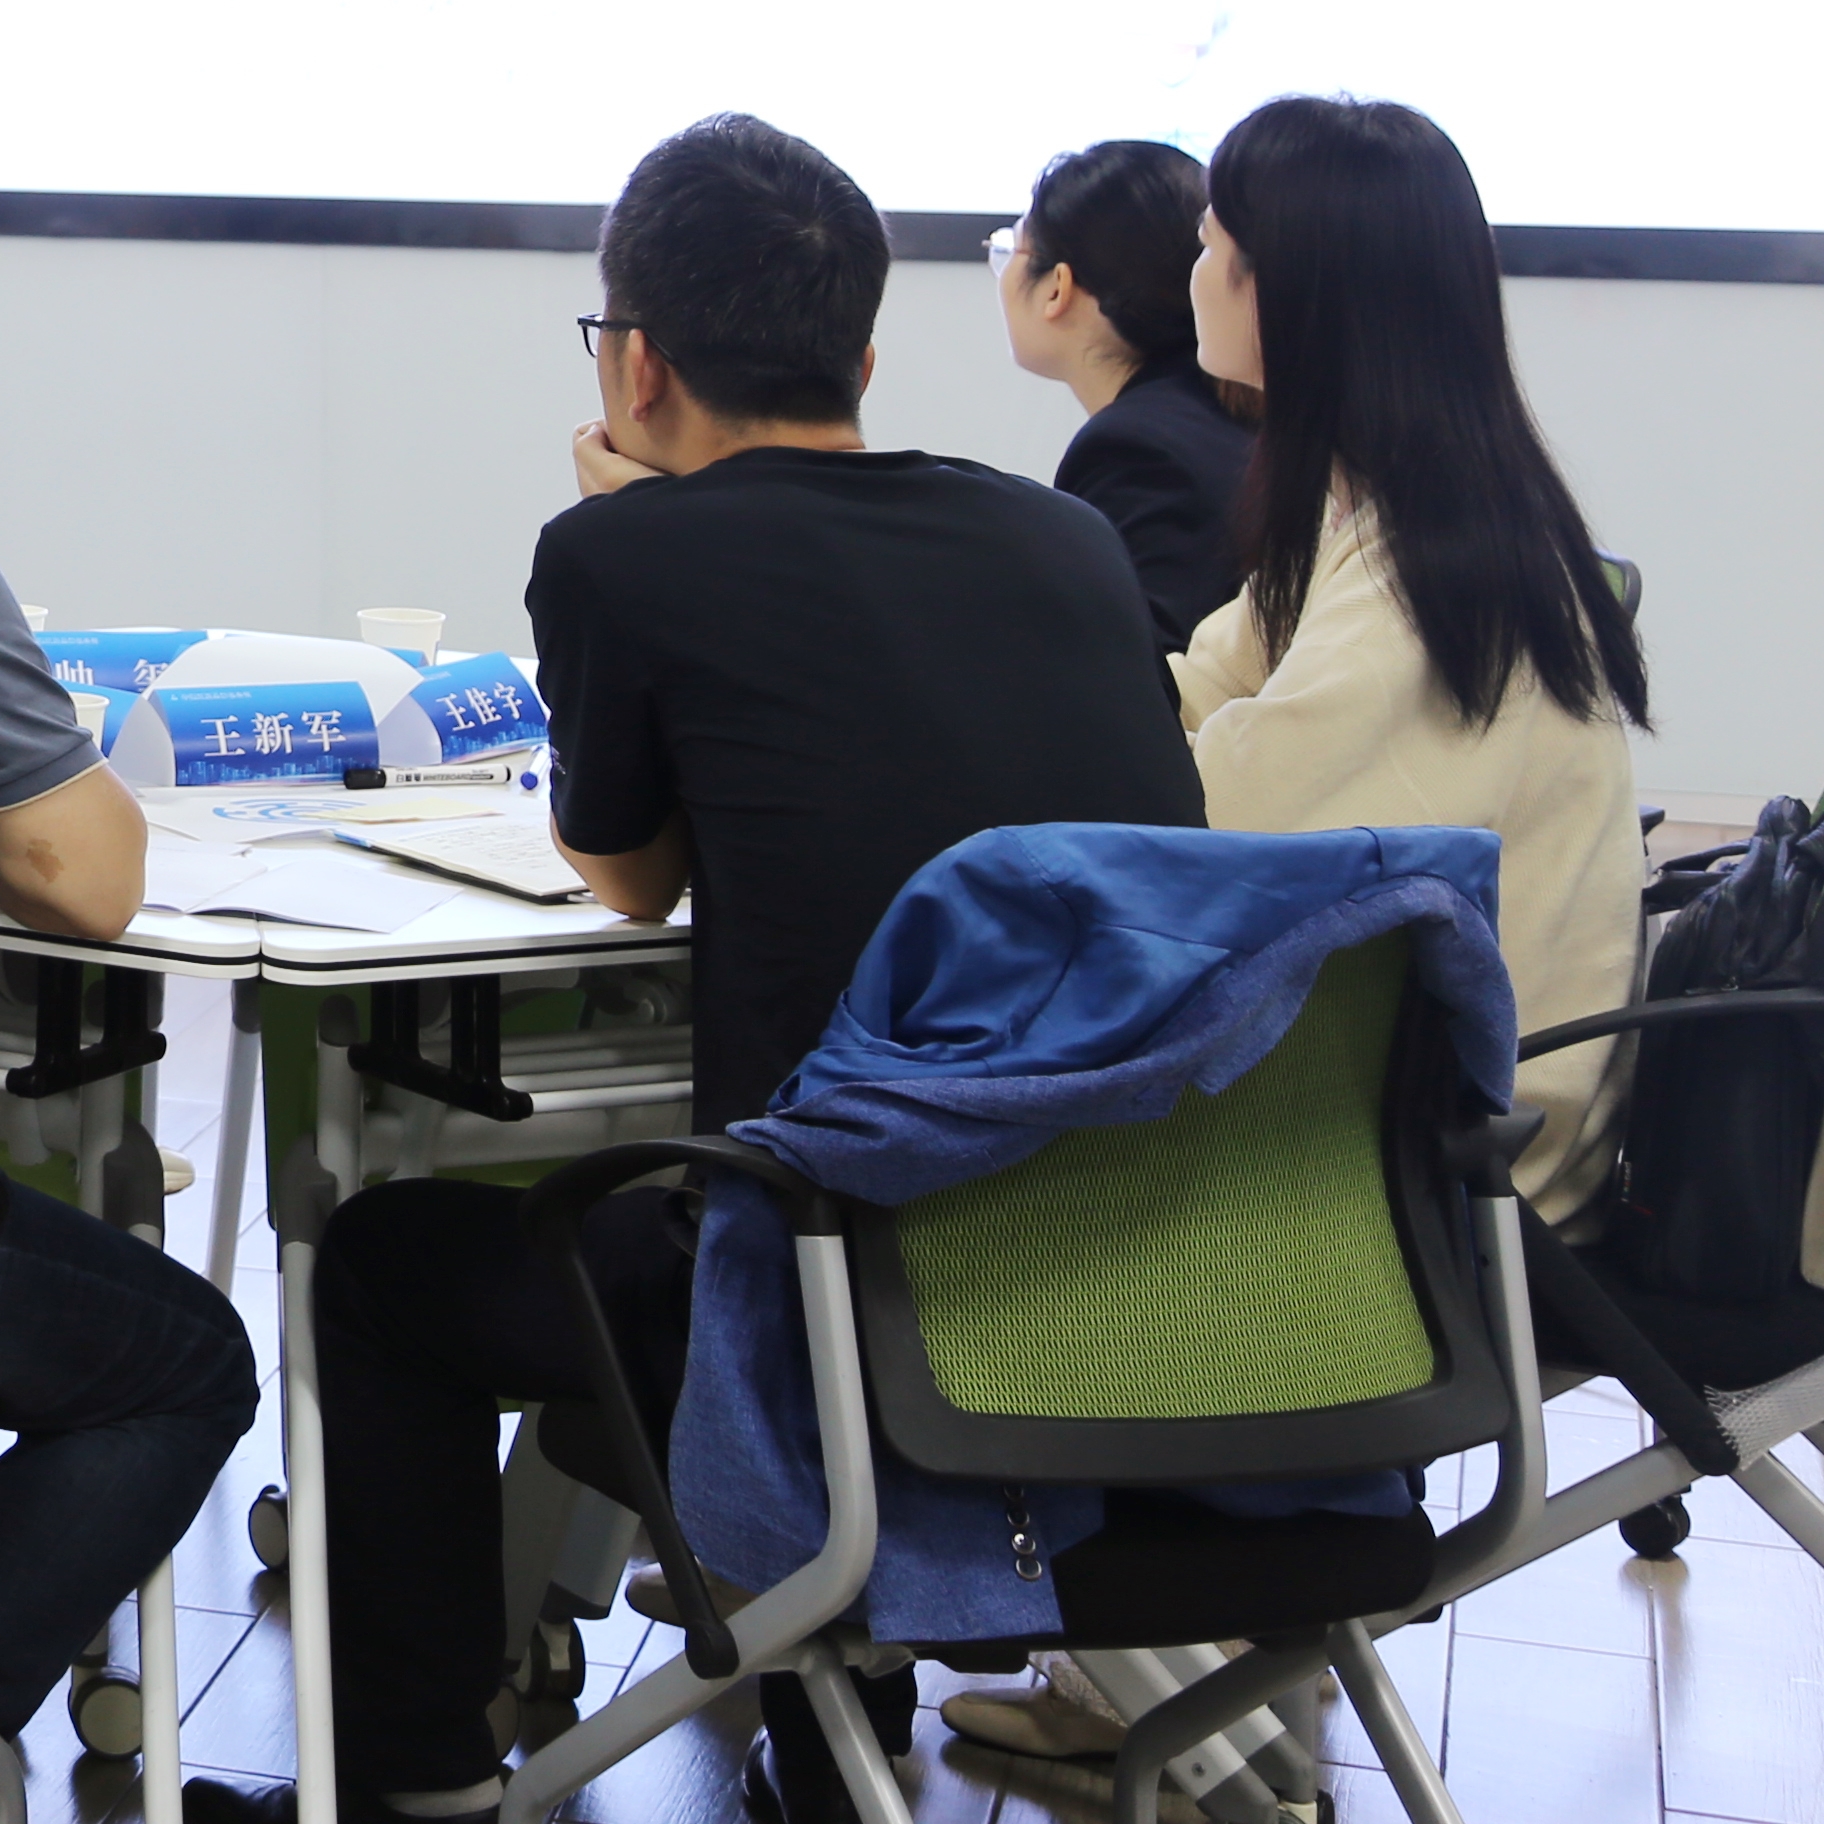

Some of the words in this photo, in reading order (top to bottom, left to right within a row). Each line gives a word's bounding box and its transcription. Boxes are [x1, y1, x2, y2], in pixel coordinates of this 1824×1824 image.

[435, 681, 523, 732] 王佳宇
[199, 709, 347, 758] 王新军
